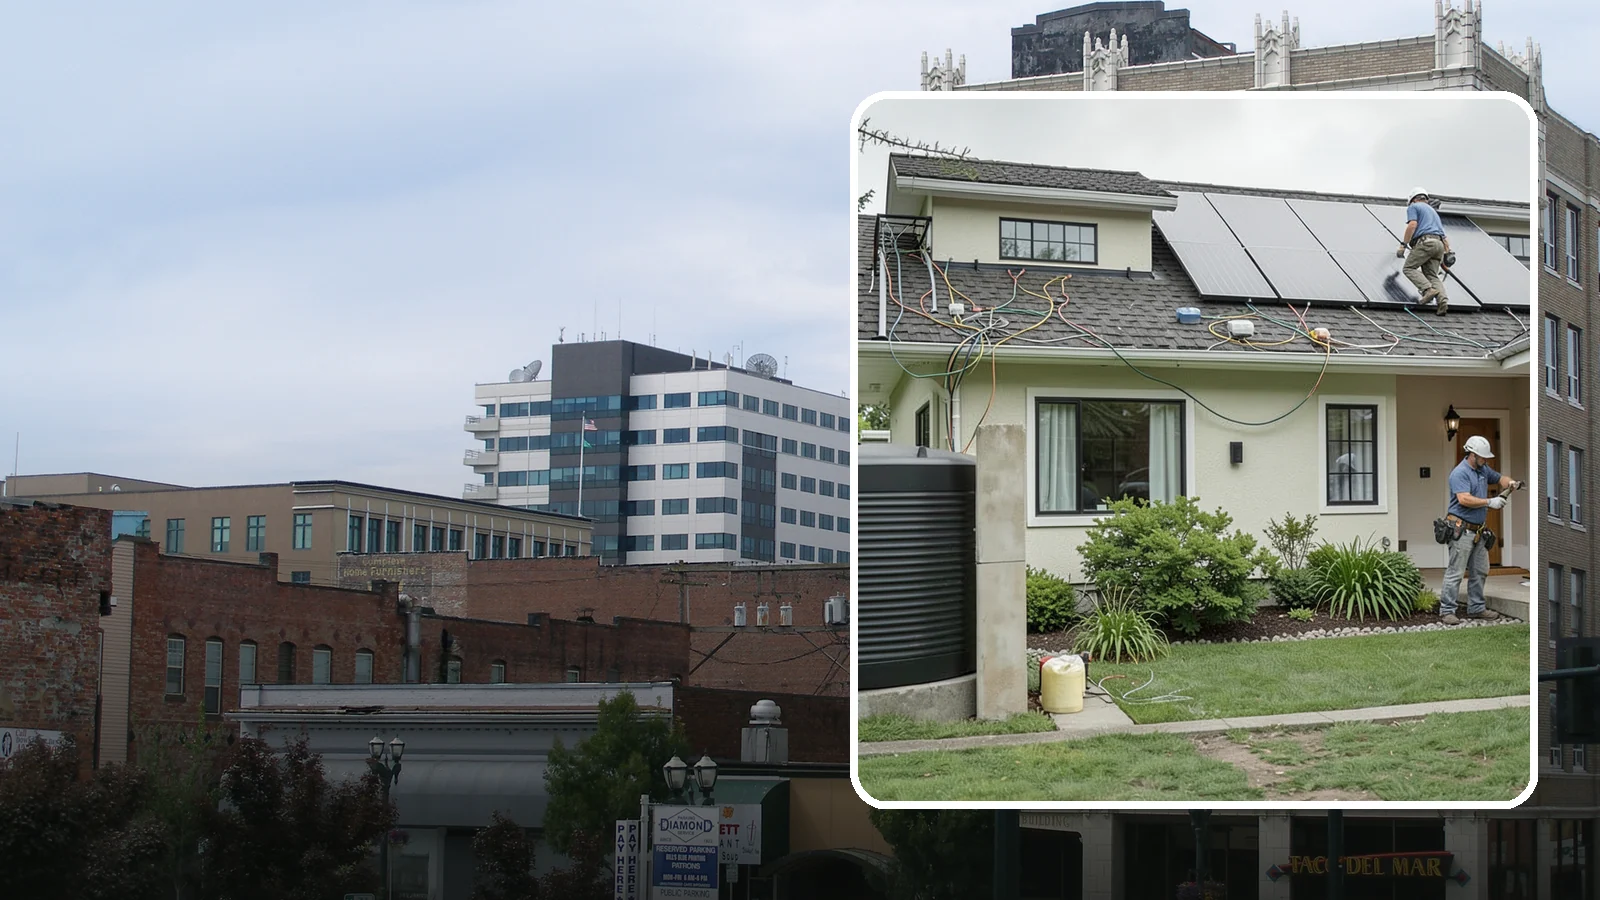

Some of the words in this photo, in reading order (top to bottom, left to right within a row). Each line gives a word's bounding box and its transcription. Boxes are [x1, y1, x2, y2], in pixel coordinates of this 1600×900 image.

[370, 566, 428, 576] Furnishers
[660, 818, 713, 833] DIAMOND
[1022, 815, 1069, 827] BUILDING
[617, 825, 625, 852] PAY
[628, 824, 636, 852] PAY
[656, 845, 688, 853] RESERVED
[689, 846, 716, 854] PARKING
[671, 862, 701, 870] PATRONS
[1346, 856, 1385, 876] DEL
[1392, 857, 1441, 876] MAR
[616, 856, 624, 893] HERE
[628, 856, 636, 893] HERE
[660, 889, 682, 897] PUBLIC
[683, 890, 710, 898] PARKING
